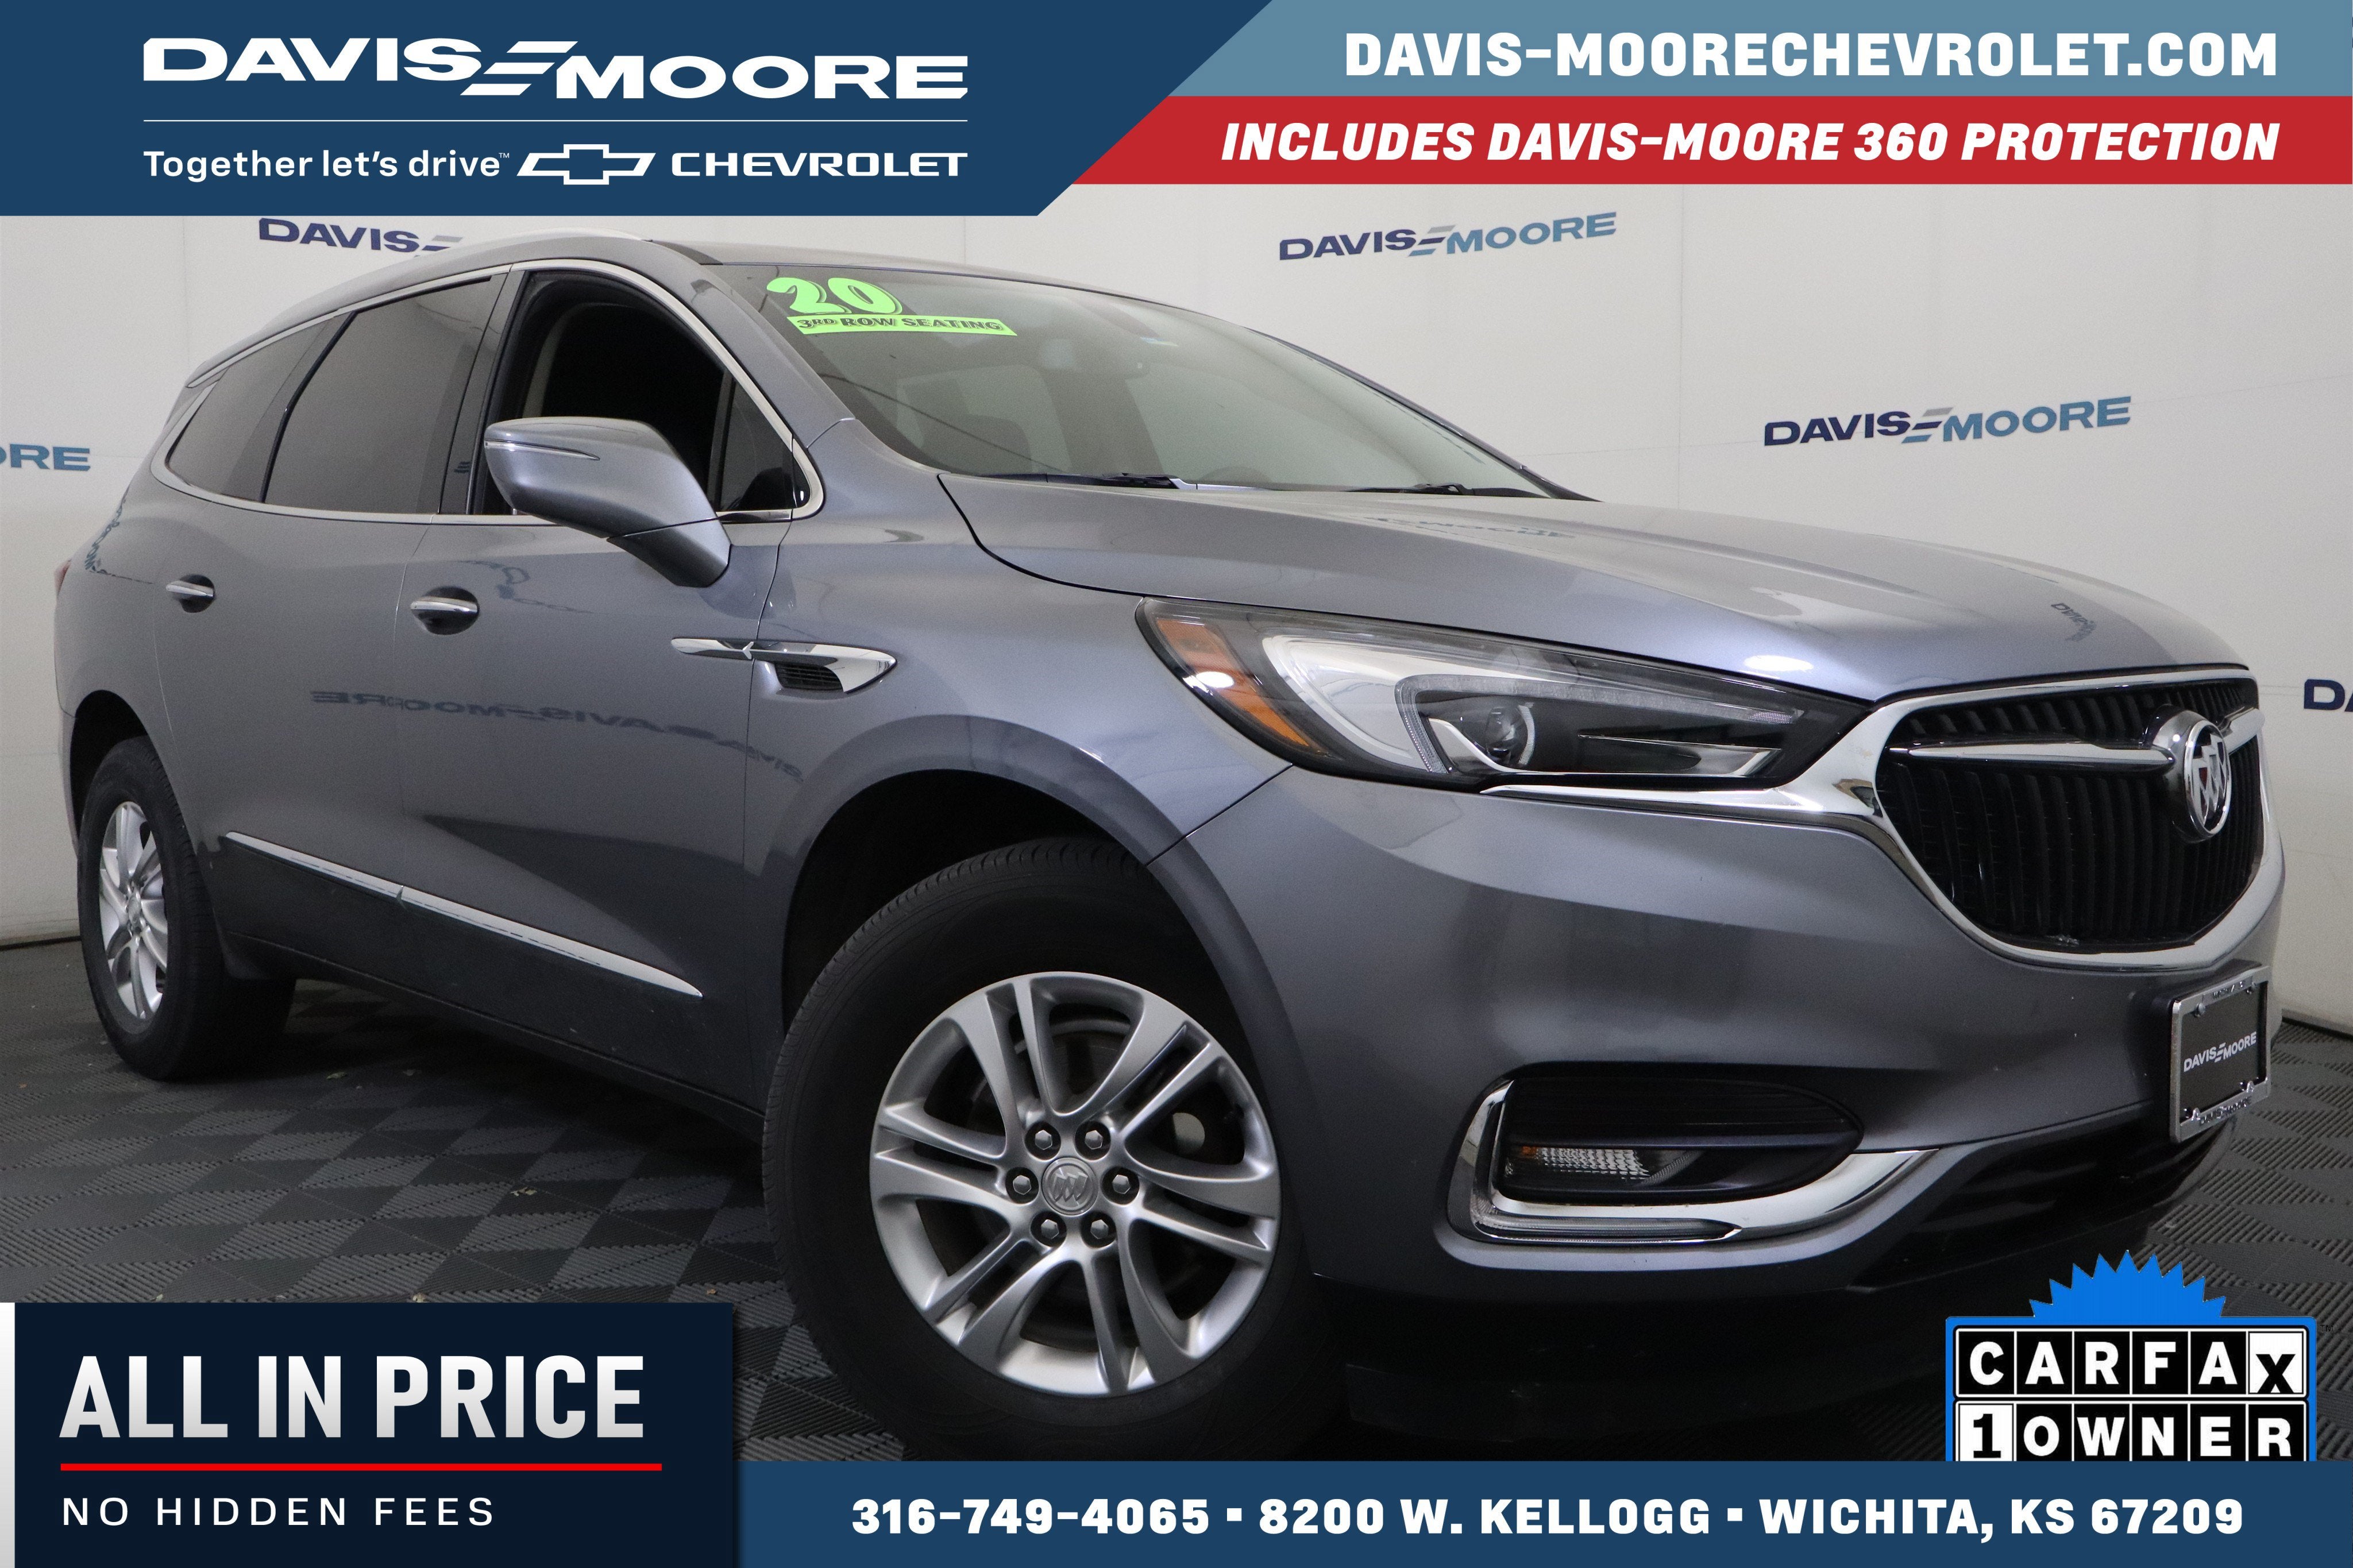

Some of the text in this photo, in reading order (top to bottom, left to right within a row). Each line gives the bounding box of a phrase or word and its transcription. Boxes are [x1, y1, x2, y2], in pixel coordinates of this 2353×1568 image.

[259, 217, 422, 253] DAVIS
[1279, 211, 1617, 260] DAVIS MOORE
[766, 277, 902, 315] 20
[841, 317, 897, 329] ROW
[902, 318, 1002, 332] SEATING
[1764, 396, 2131, 446] DAVIS MOORE
[0, 443, 91, 471] RE
[2183, 1031, 2257, 1072] DAVIS MOORE
